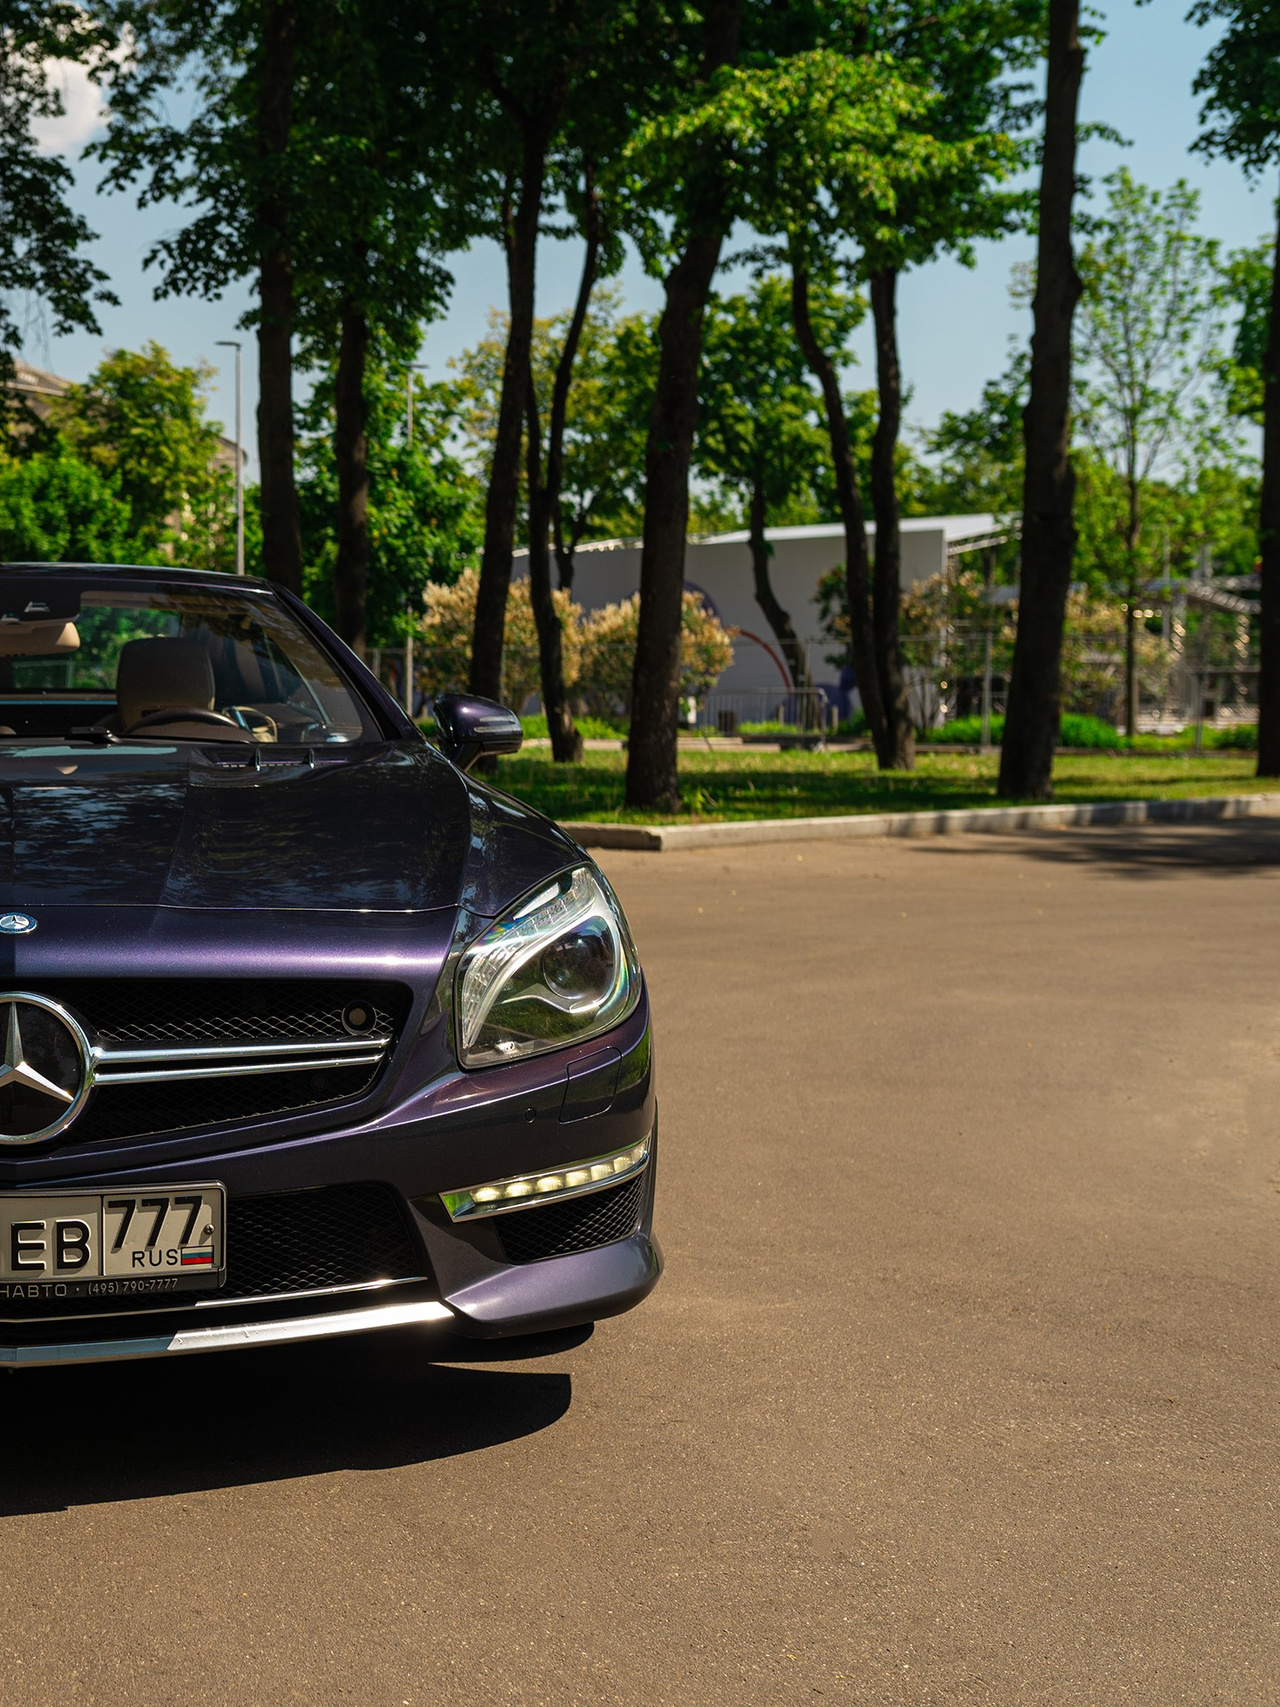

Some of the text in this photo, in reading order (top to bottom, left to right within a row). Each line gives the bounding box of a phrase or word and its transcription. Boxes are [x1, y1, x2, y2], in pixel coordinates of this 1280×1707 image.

[107, 1196, 202, 1251] 777
[131, 1247, 179, 1268] RUS
[88, 1282, 119, 1295] (495)
[123, 1278, 178, 1292] 790-7777
